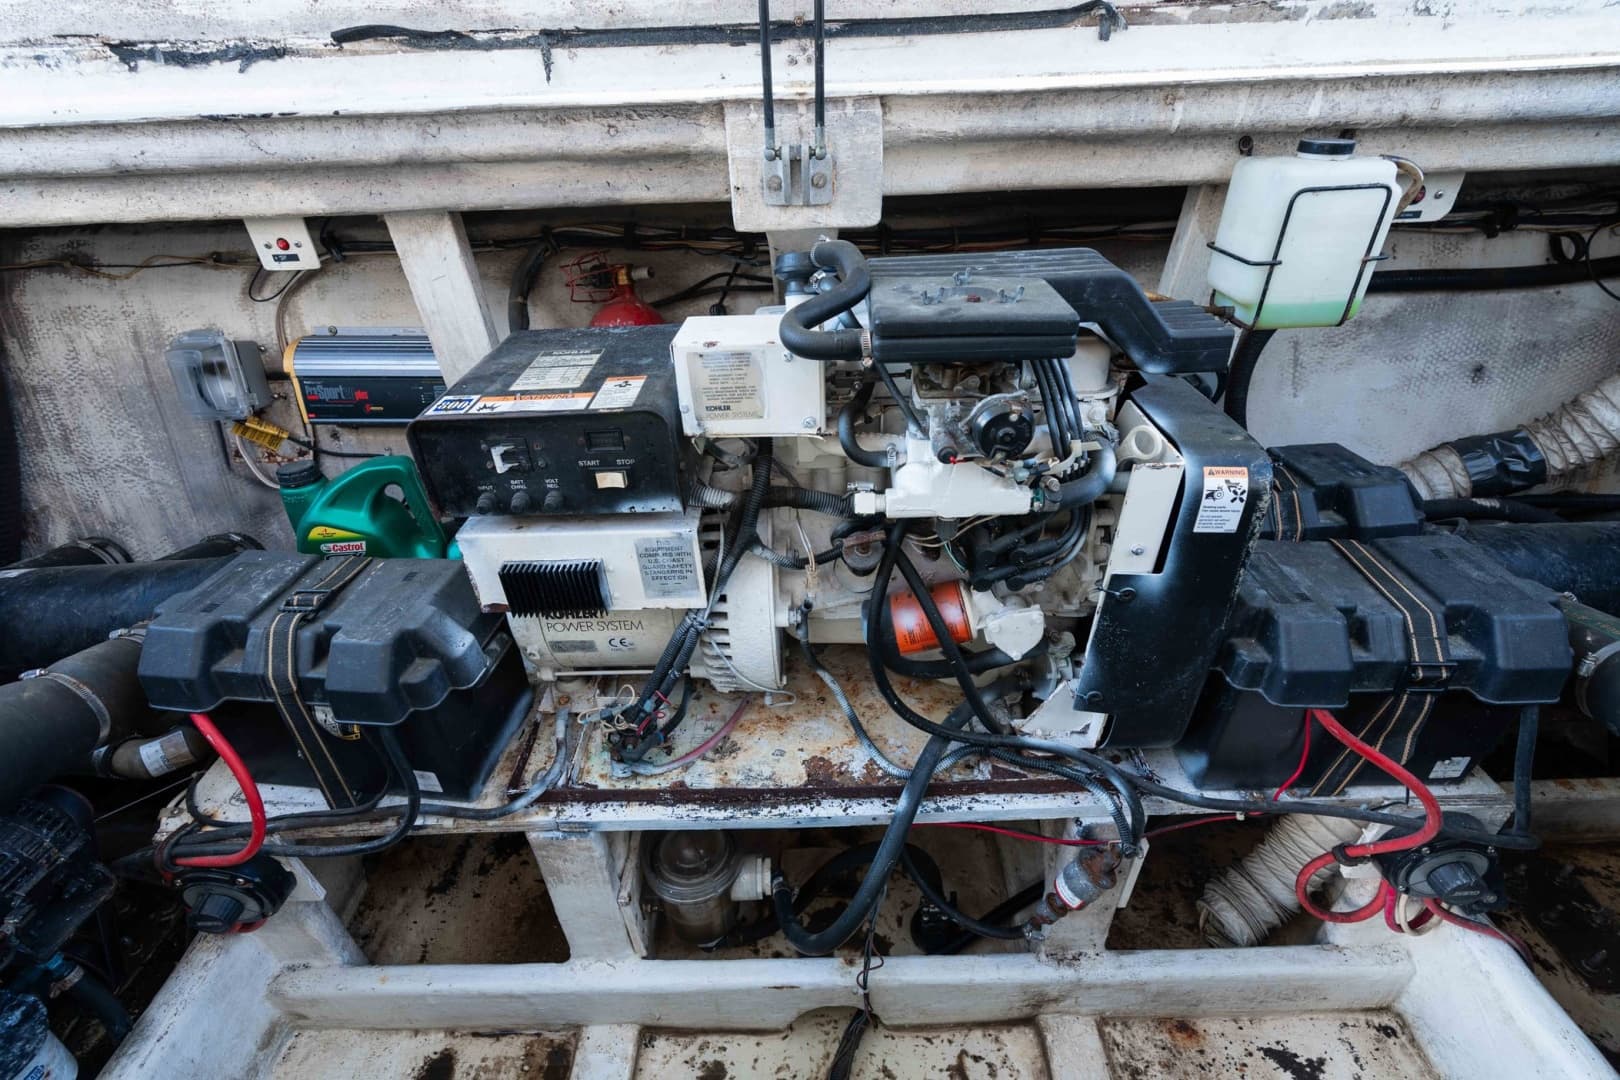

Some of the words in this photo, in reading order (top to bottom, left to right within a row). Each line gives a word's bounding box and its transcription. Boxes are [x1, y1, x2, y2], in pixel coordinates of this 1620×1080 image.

[435, 400, 470, 410] 800
[705, 404, 731, 412] KOHLER
[332, 543, 364, 552] Castrol
[546, 621, 593, 632] POWER
[596, 620, 644, 631] SYSTEM
